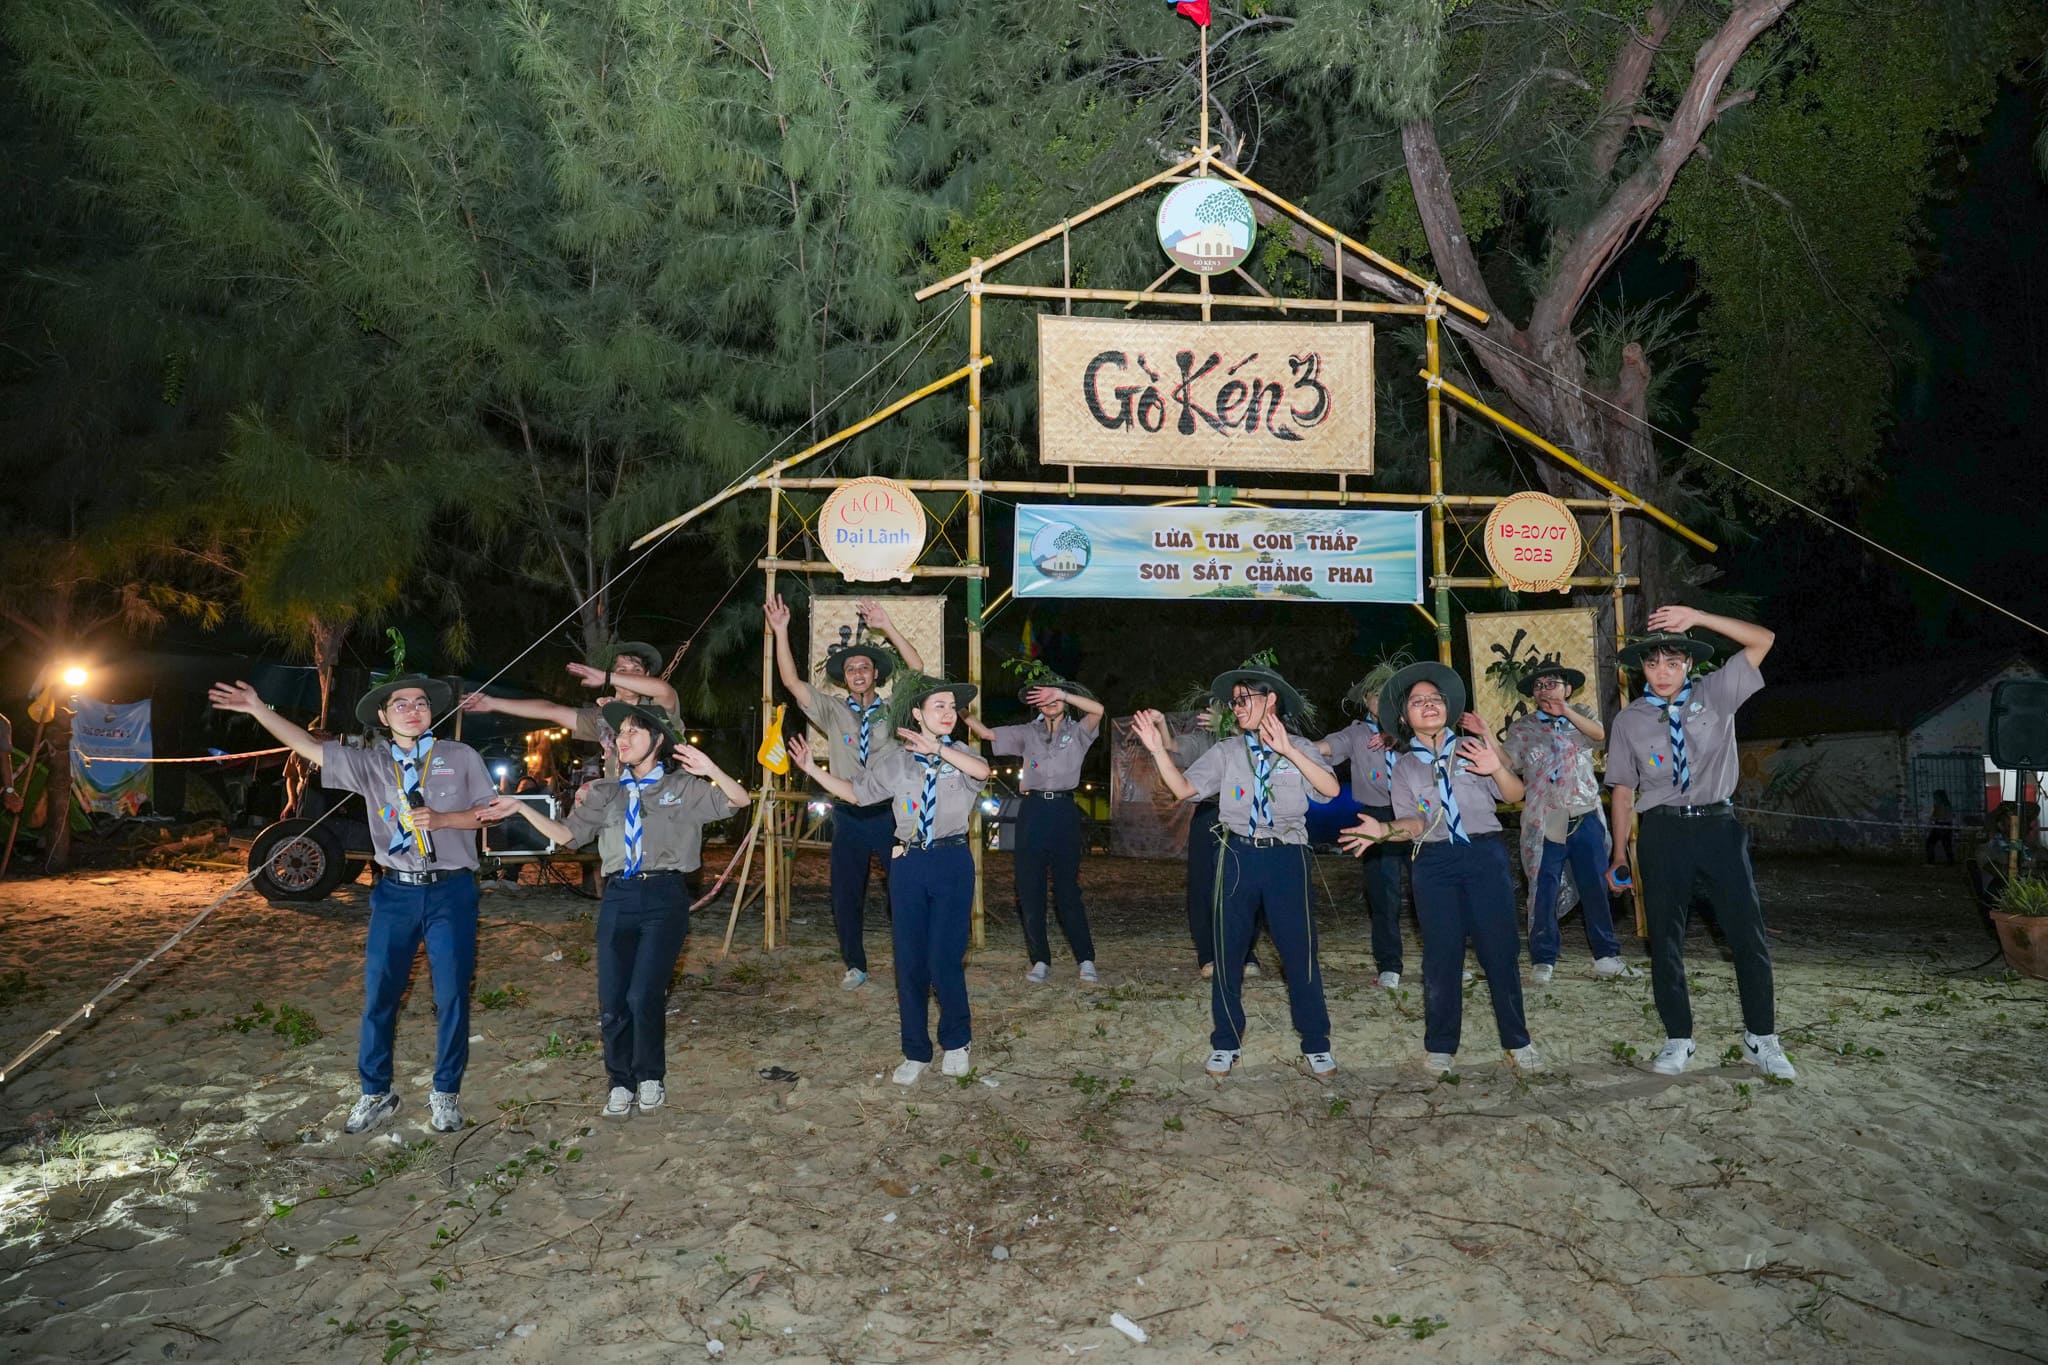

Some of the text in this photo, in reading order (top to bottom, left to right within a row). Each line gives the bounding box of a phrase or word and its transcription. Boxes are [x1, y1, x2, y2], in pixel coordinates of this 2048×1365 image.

[1083, 350, 1332, 441] Gò Kén 3
[836, 527, 911, 549] Đại Lãnh
[1204, 532, 1240, 549] TIN
[1252, 533, 1294, 550] CON
[1306, 528, 1359, 551] THẮP
[1499, 524, 1567, 540] 19-20/07
[1514, 547, 1553, 563] 2025
[1139, 563, 1181, 581] SON
[1192, 557, 1233, 581] SẮT
[1327, 566, 1374, 583] PHAI
